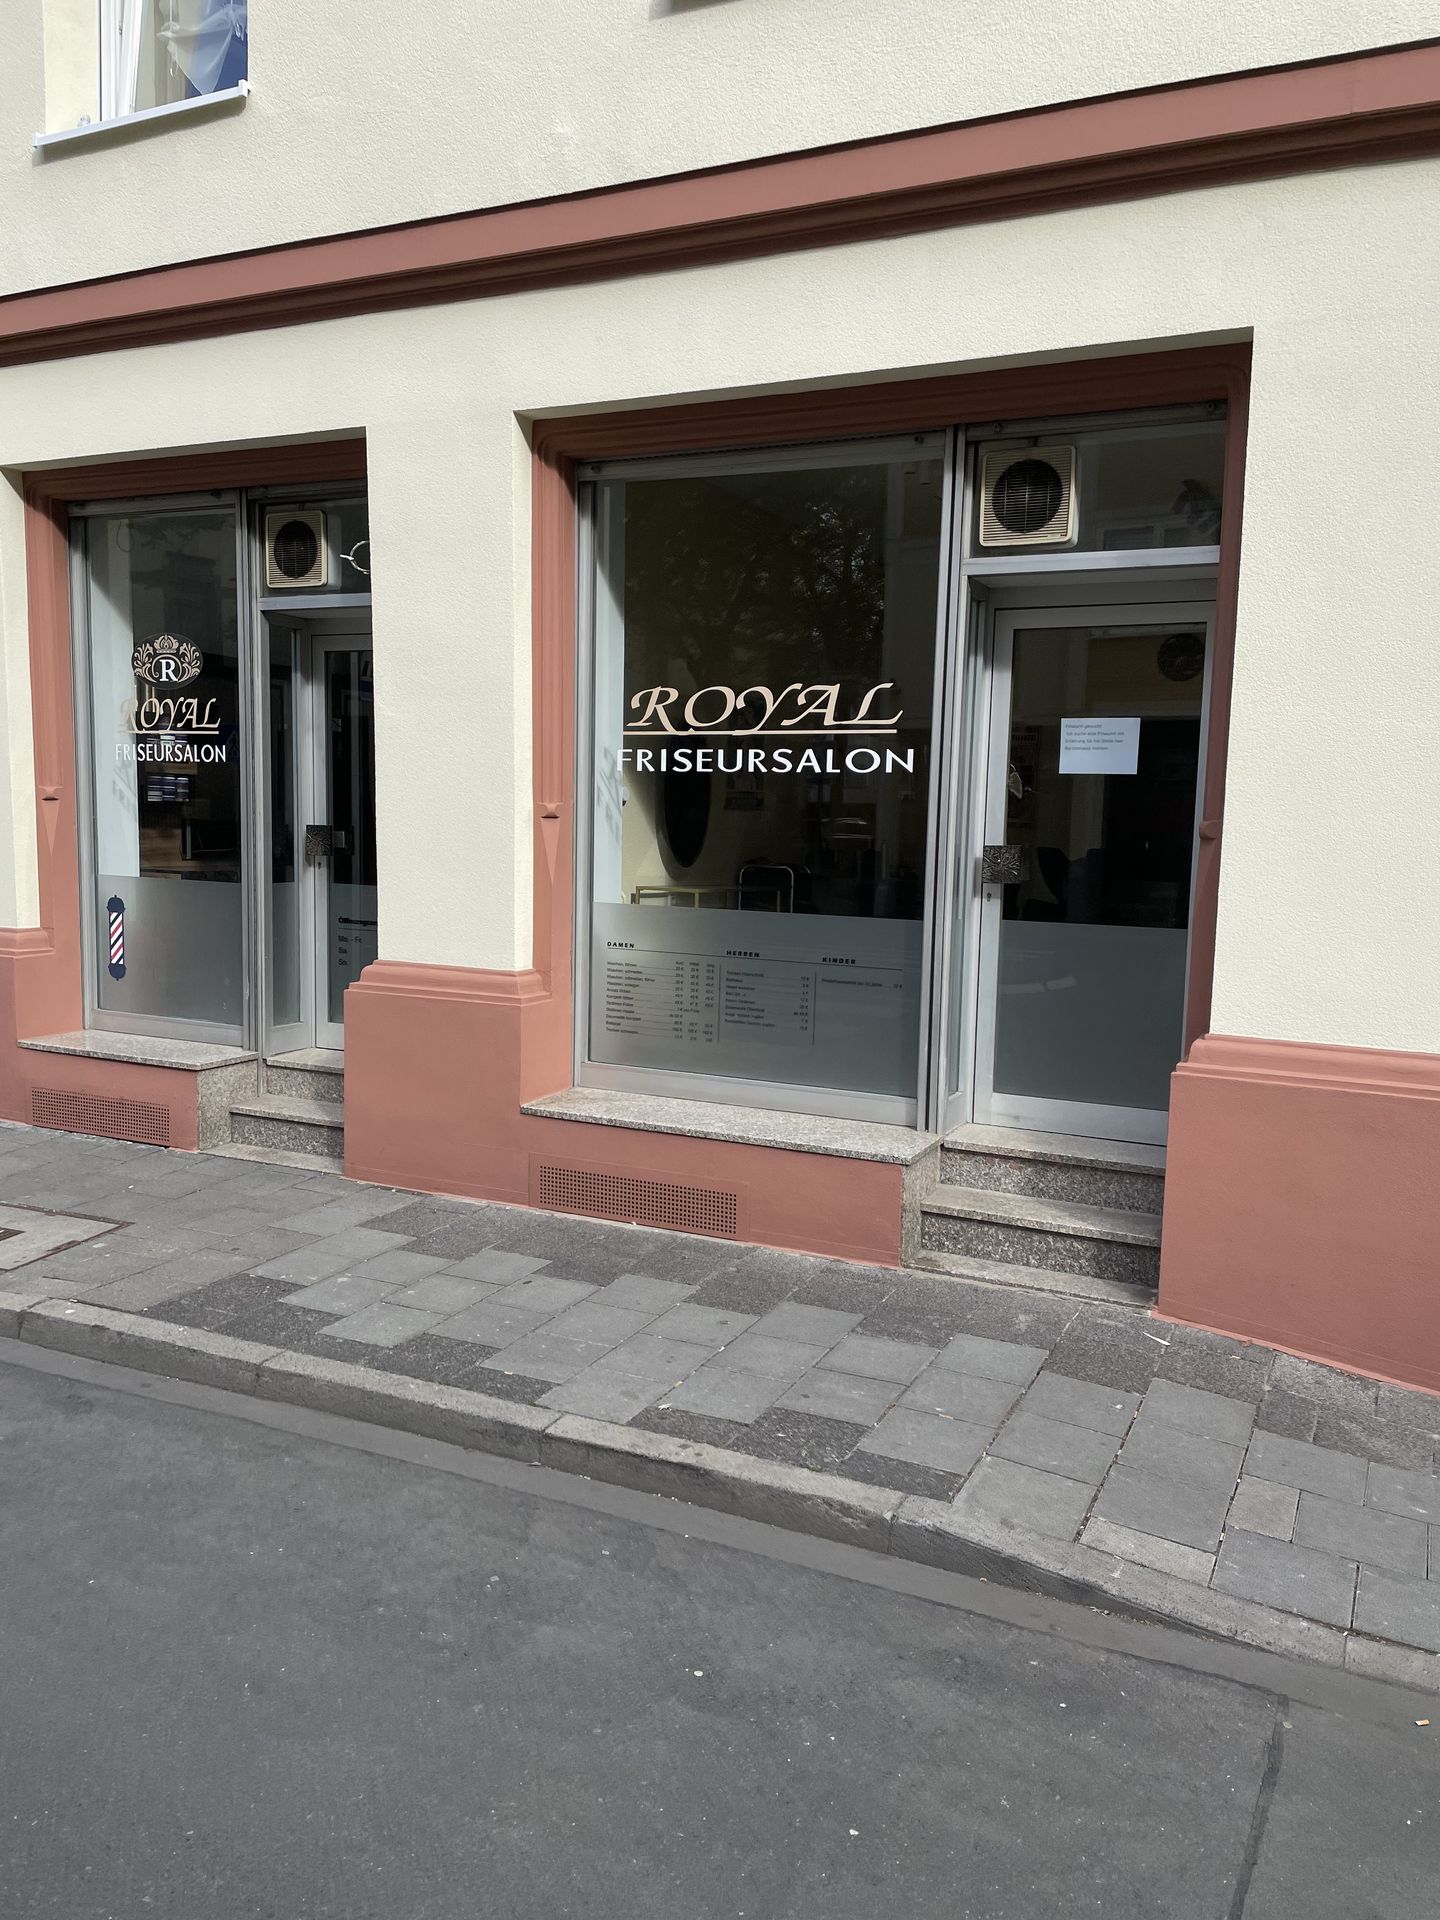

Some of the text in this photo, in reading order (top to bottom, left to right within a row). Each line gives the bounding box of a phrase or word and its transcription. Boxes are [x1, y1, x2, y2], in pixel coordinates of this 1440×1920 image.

[159, 659, 178, 682] R
[117, 696, 221, 734] ROYAL
[625, 683, 903, 735] ROYAL
[115, 743, 226, 763] FRISEURSALON
[616, 748, 915, 773] FRISEURSALON
[607, 941, 635, 949] DAMEN
[822, 957, 856, 965] KINDER
